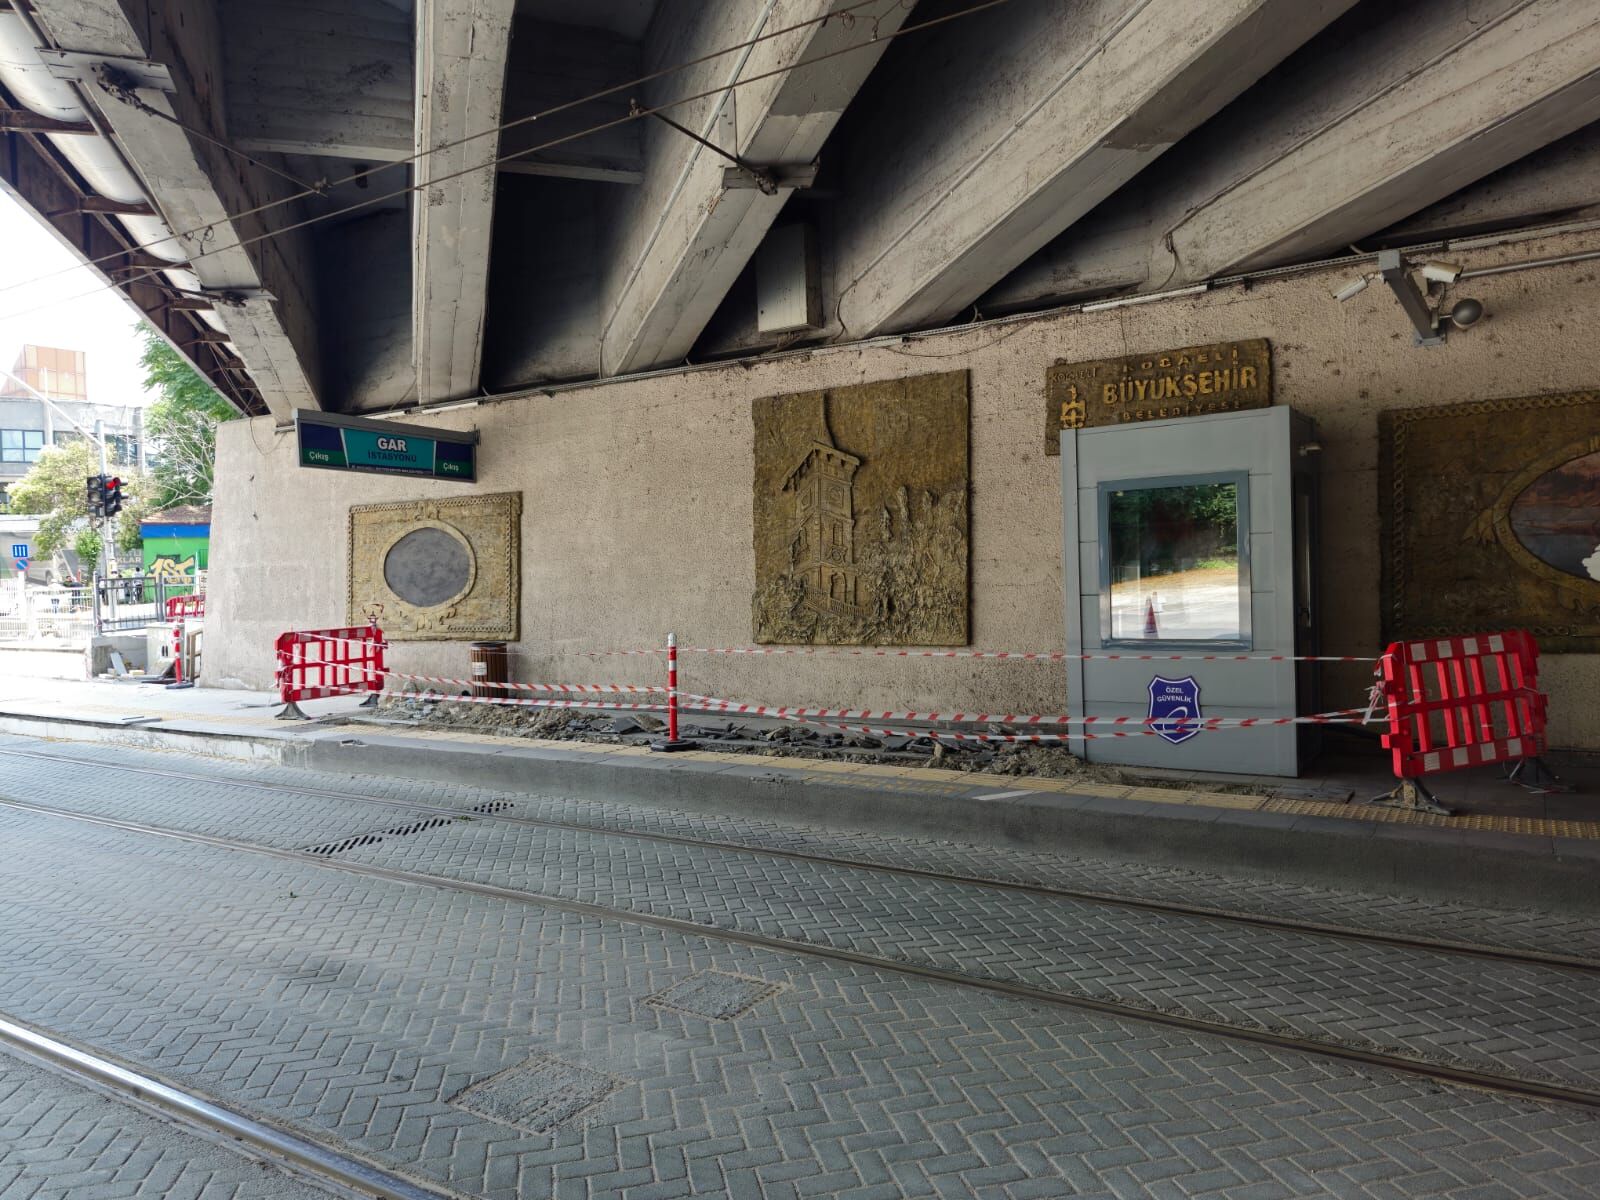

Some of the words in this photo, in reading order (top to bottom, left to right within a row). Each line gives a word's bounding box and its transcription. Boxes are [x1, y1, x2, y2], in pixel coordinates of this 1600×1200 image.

[377, 437, 407, 452] GAR
[308, 451, 329, 462] Çıkış
[442, 462, 459, 471] Çıkış
[1156, 695, 1192, 703] GÜVENLİK
